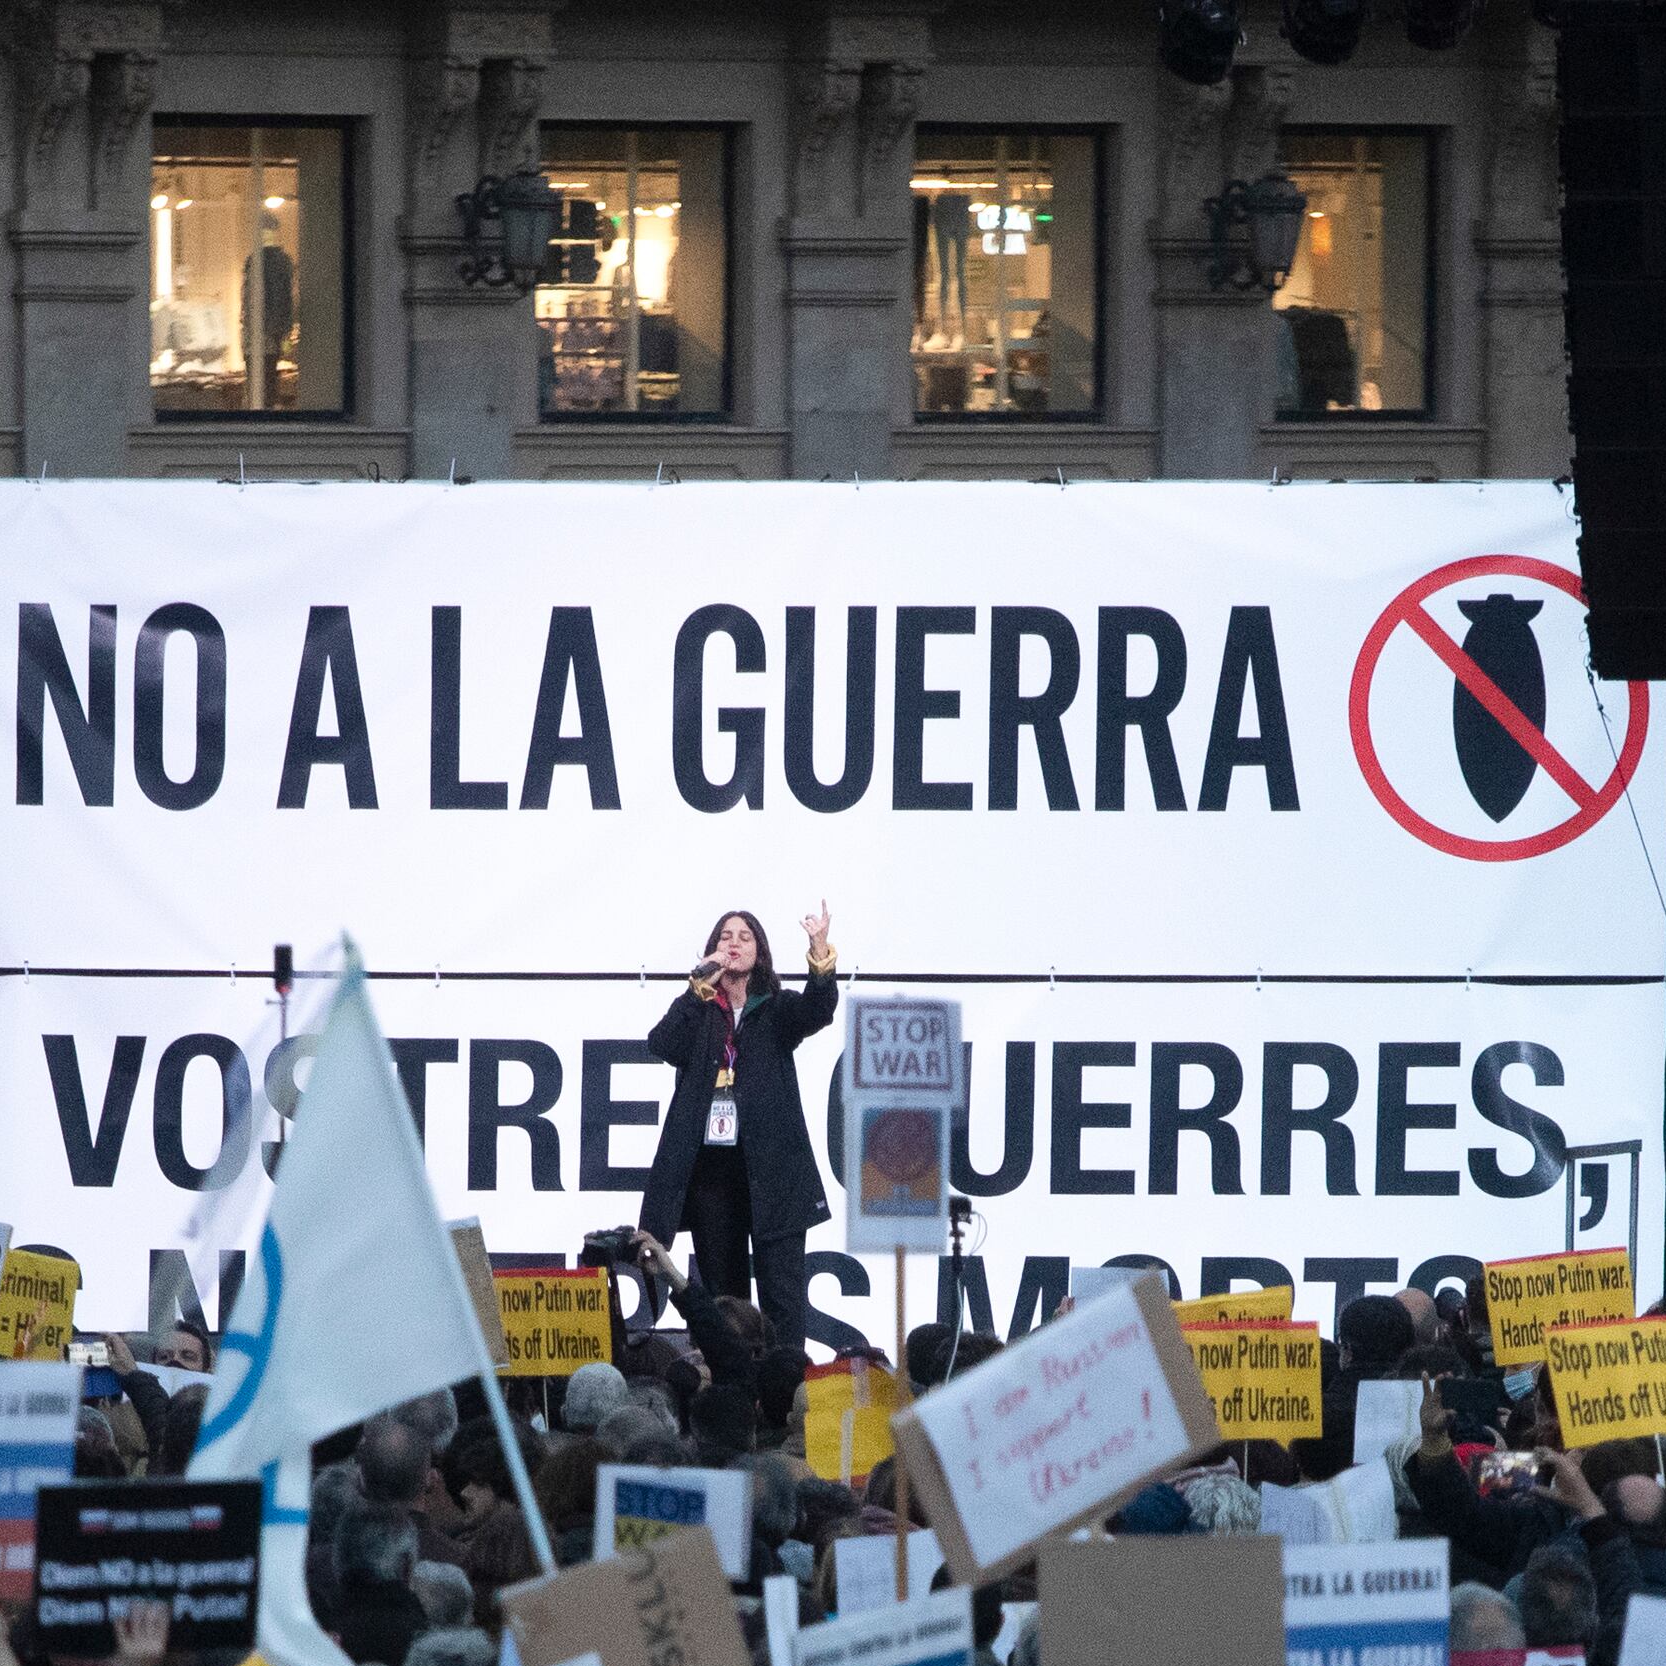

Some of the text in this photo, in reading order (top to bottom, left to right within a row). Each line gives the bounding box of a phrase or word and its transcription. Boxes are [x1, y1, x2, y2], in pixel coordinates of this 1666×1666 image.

[16, 602, 1300, 813] NO A LA GUERRA
[866, 1015, 944, 1043] STOP
[872, 1050, 943, 1078] WAR
[41, 1032, 669, 1192] VOTRE
[827, 1040, 1609, 1232] UERRES,
[2, 1265, 69, 1310] riminal,
[501, 1280, 605, 1313] now Putin war.
[1488, 1270, 1523, 1307] Stop
[1526, 1271, 1555, 1299] now
[1557, 1261, 1596, 1294] Putin
[1597, 1264, 1630, 1290] war.
[524, 1327, 543, 1361] off
[545, 1327, 605, 1360] Ukraine.
[1500, 1316, 1546, 1349] Hands
[1199, 1334, 1318, 1370] now Putin war.
[1549, 1336, 1592, 1380] Stop
[1594, 1339, 1631, 1368] now
[1222, 1387, 1315, 1422] off Ukraine.
[1565, 1387, 1627, 1429] Hands
[1629, 1382, 1653, 1419] off
[616, 1480, 706, 1521] STOP
[99, 1558, 133, 1587] NO
[1285, 1565, 1442, 1599] TRA LA GUERRA!
